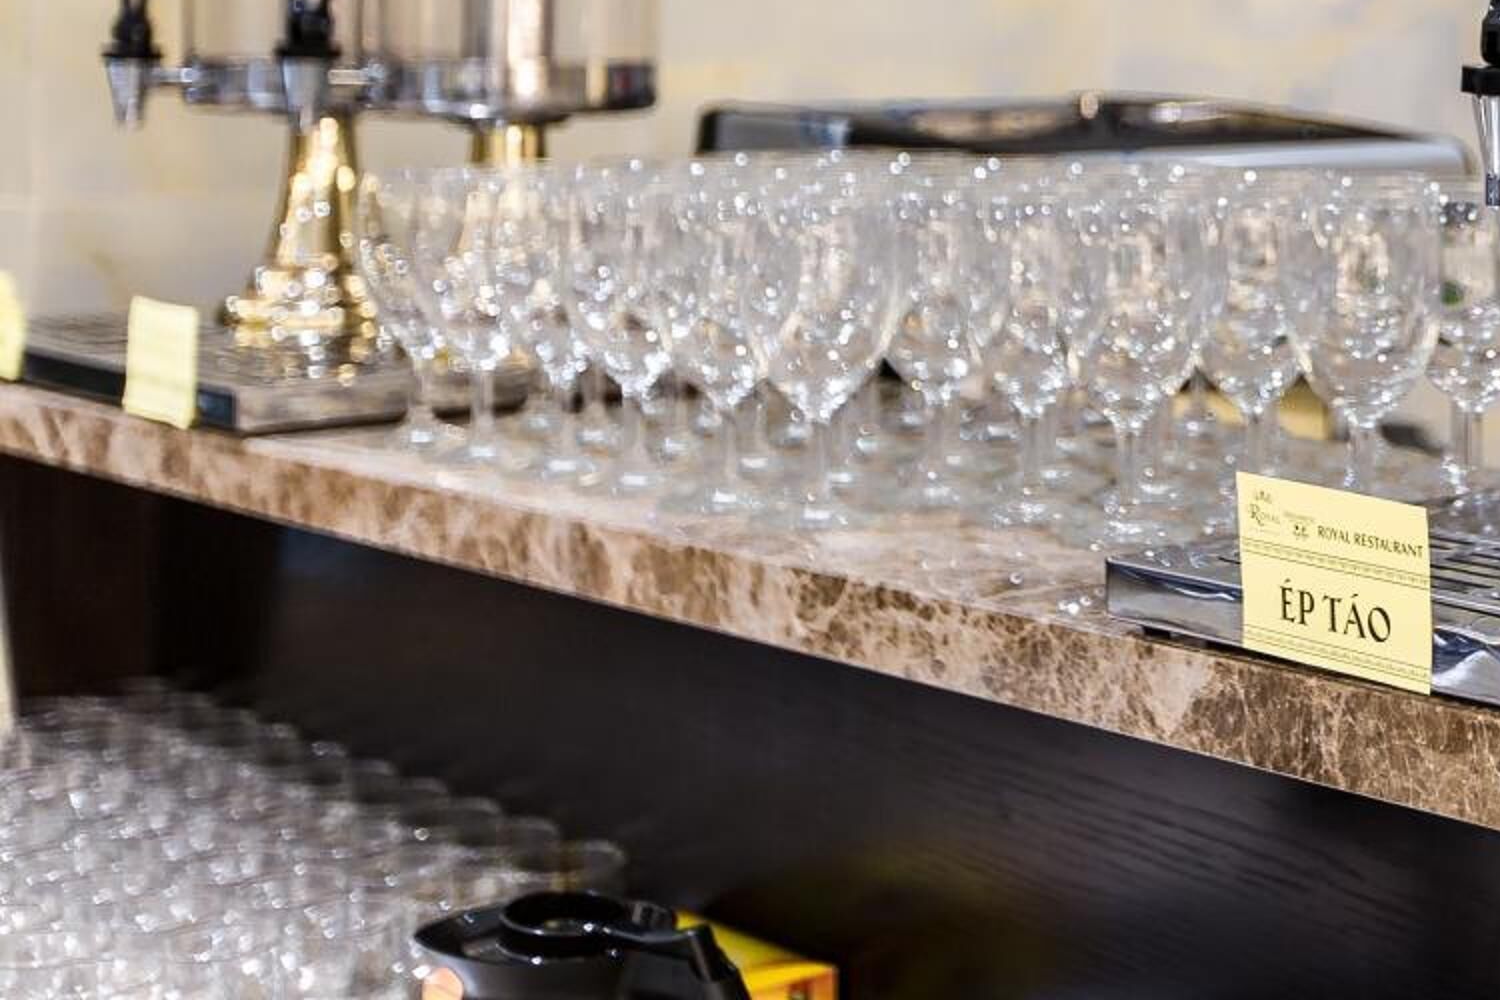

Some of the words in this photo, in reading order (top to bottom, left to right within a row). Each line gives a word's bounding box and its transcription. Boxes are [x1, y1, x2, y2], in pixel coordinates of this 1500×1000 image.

[1316, 525, 1351, 545] ROYAL
[1353, 531, 1425, 559] RESTAURANT
[1279, 578, 1316, 626] ÉP
[1322, 593, 1392, 643] TÁO
